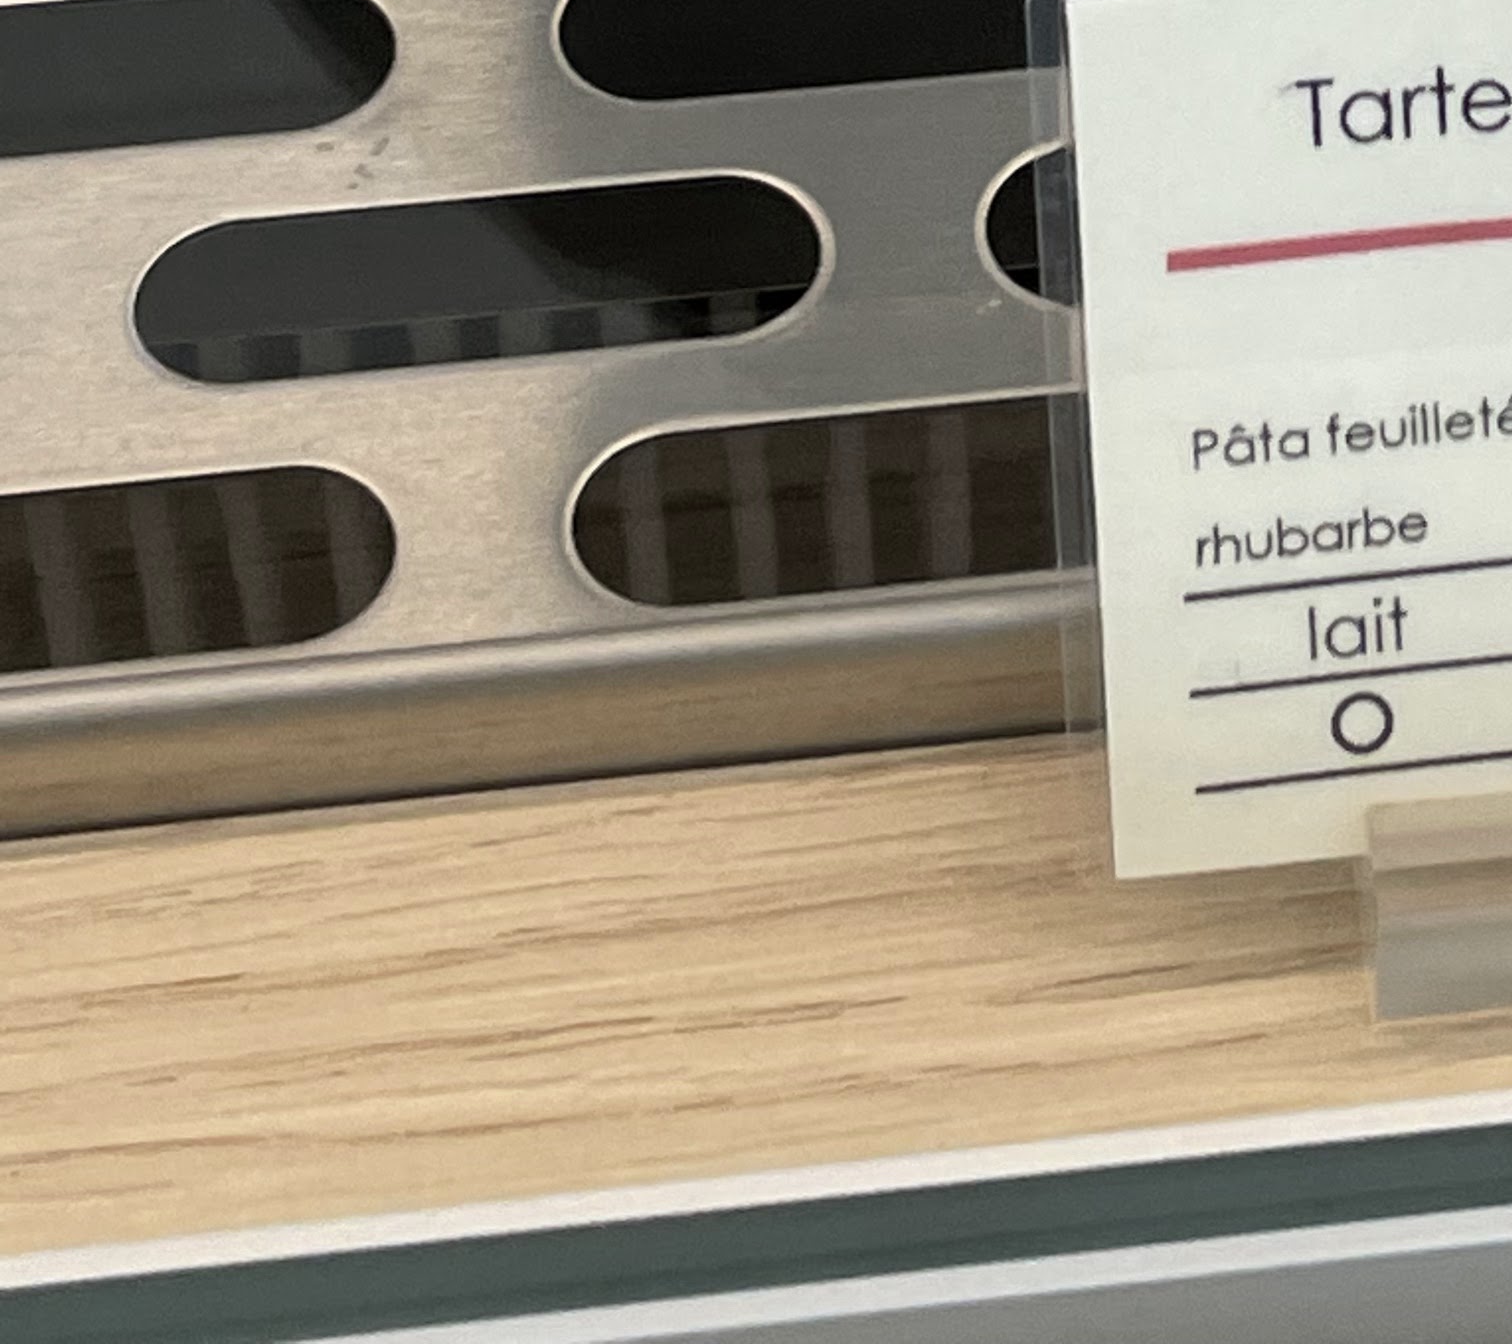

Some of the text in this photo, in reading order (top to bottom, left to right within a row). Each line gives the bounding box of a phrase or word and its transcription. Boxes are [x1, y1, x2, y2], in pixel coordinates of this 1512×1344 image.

[1191, 421, 1310, 472] Pâta
[1195, 506, 1429, 568] rhubarbe
[1307, 595, 1409, 661] lait
